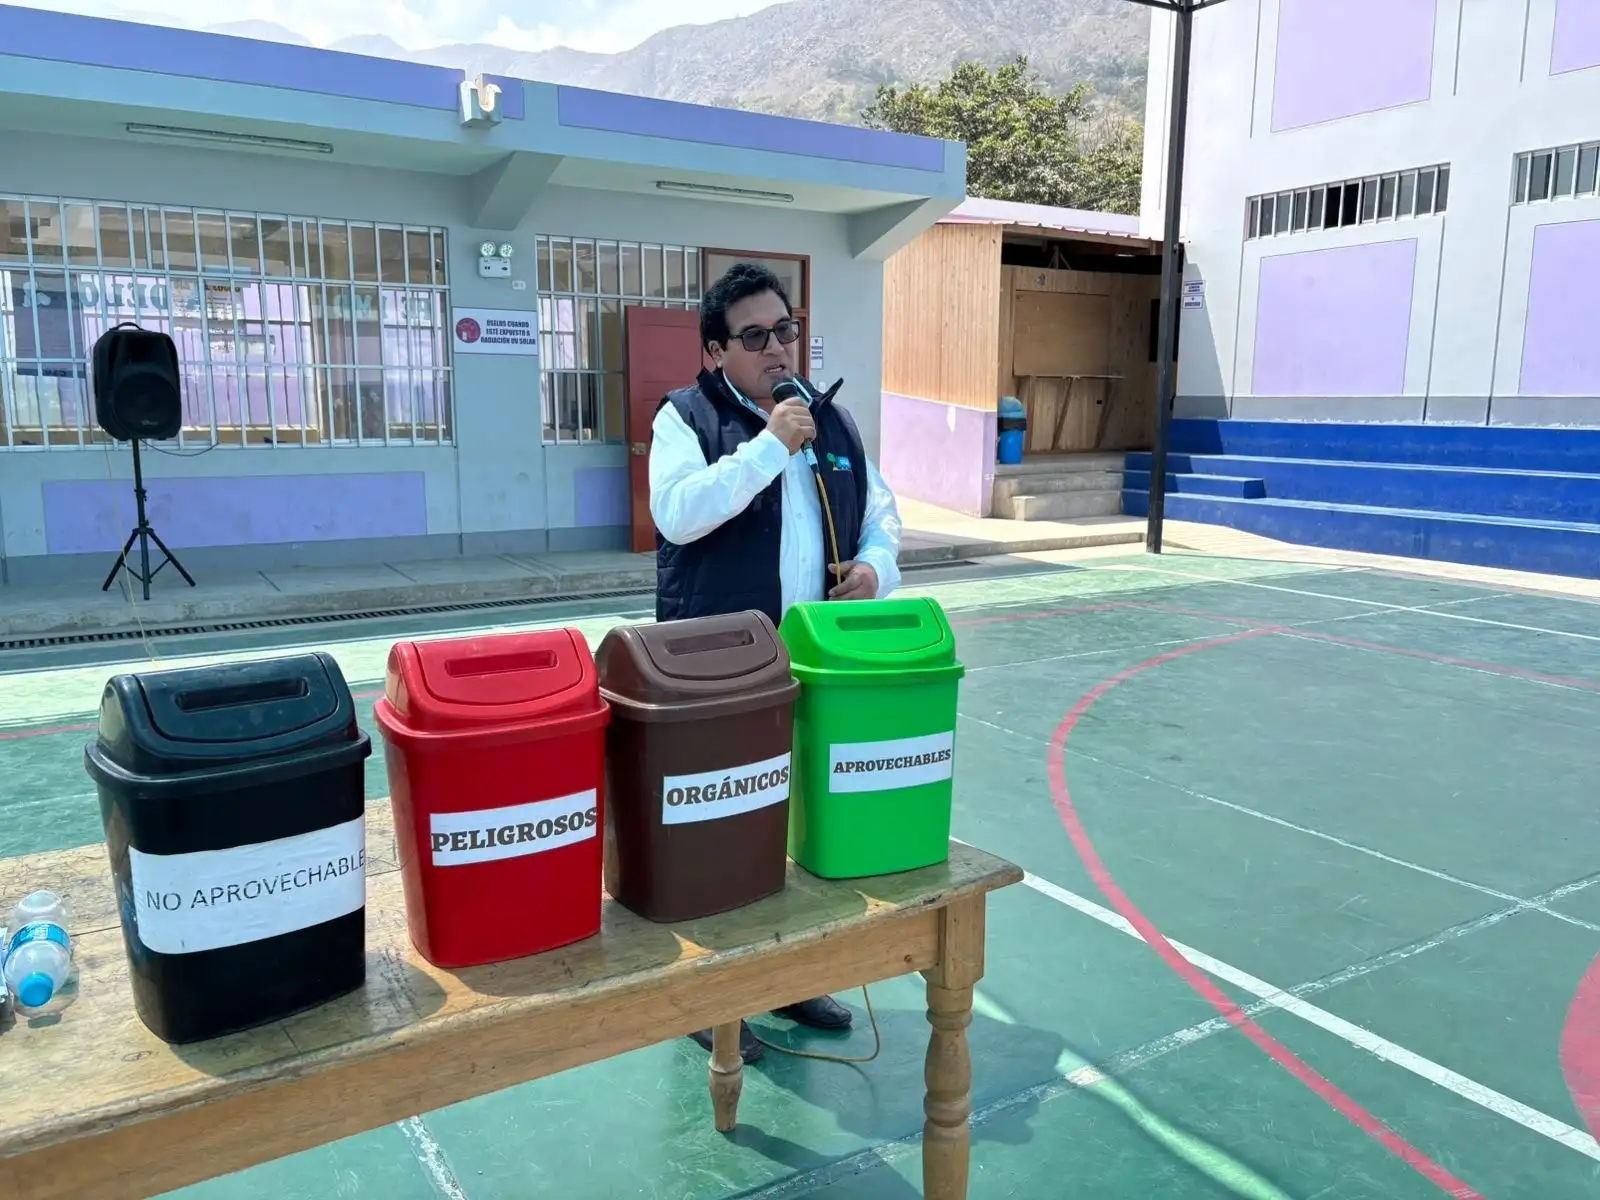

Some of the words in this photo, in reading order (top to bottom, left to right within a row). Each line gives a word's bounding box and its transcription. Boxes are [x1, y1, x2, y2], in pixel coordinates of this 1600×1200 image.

[499, 328, 526, 336] EXPUESTO
[507, 320, 529, 328] CUANDO
[833, 748, 951, 774] APROVECHABLES
[666, 765, 789, 807] ORGÁNICOS
[431, 806, 599, 852] PELIGROSOS
[146, 890, 182, 912] NO
